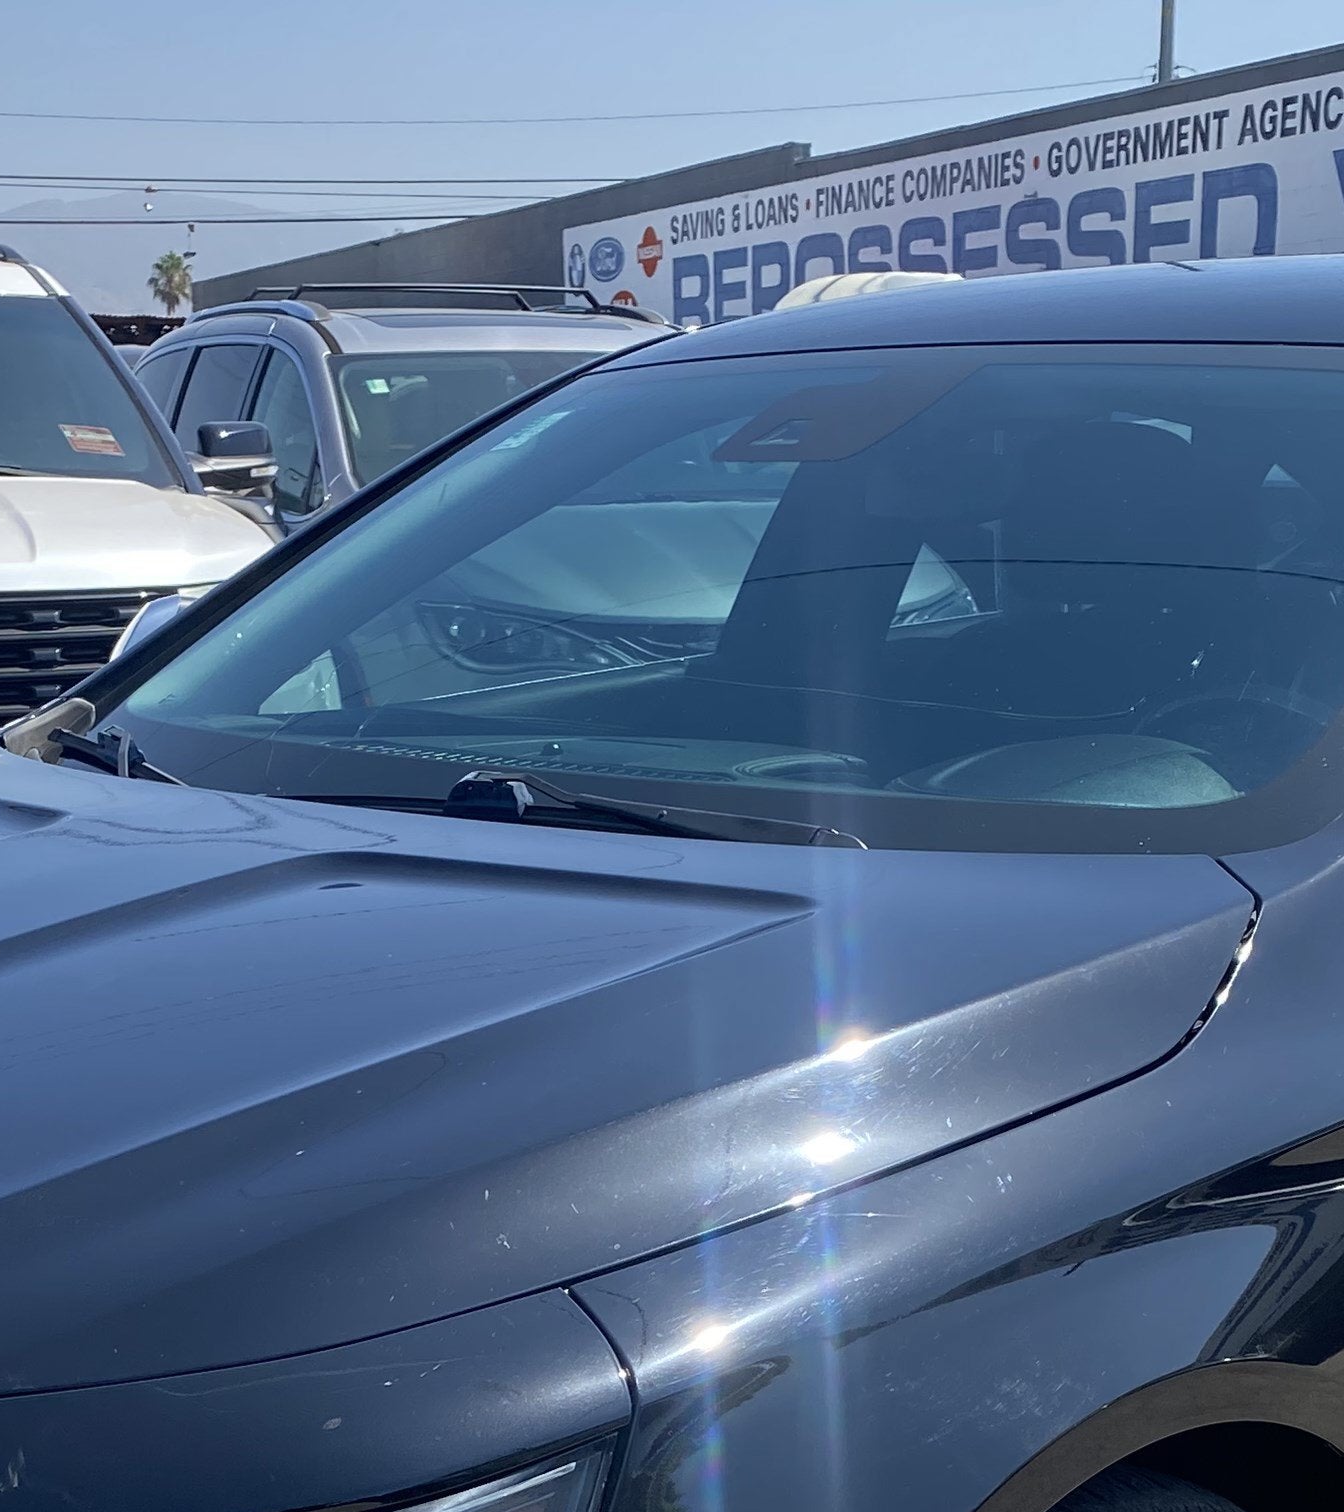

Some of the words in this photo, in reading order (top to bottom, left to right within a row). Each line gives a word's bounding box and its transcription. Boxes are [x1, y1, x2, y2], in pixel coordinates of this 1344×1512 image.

[669, 207, 726, 245] SAVING
[731, 203, 741, 233] &
[745, 193, 799, 231] LOANS
[815, 174, 896, 219] FINANCE
[901, 148, 1026, 202] COMPANIES
[1047, 109, 1231, 178] GOVERNMENT
